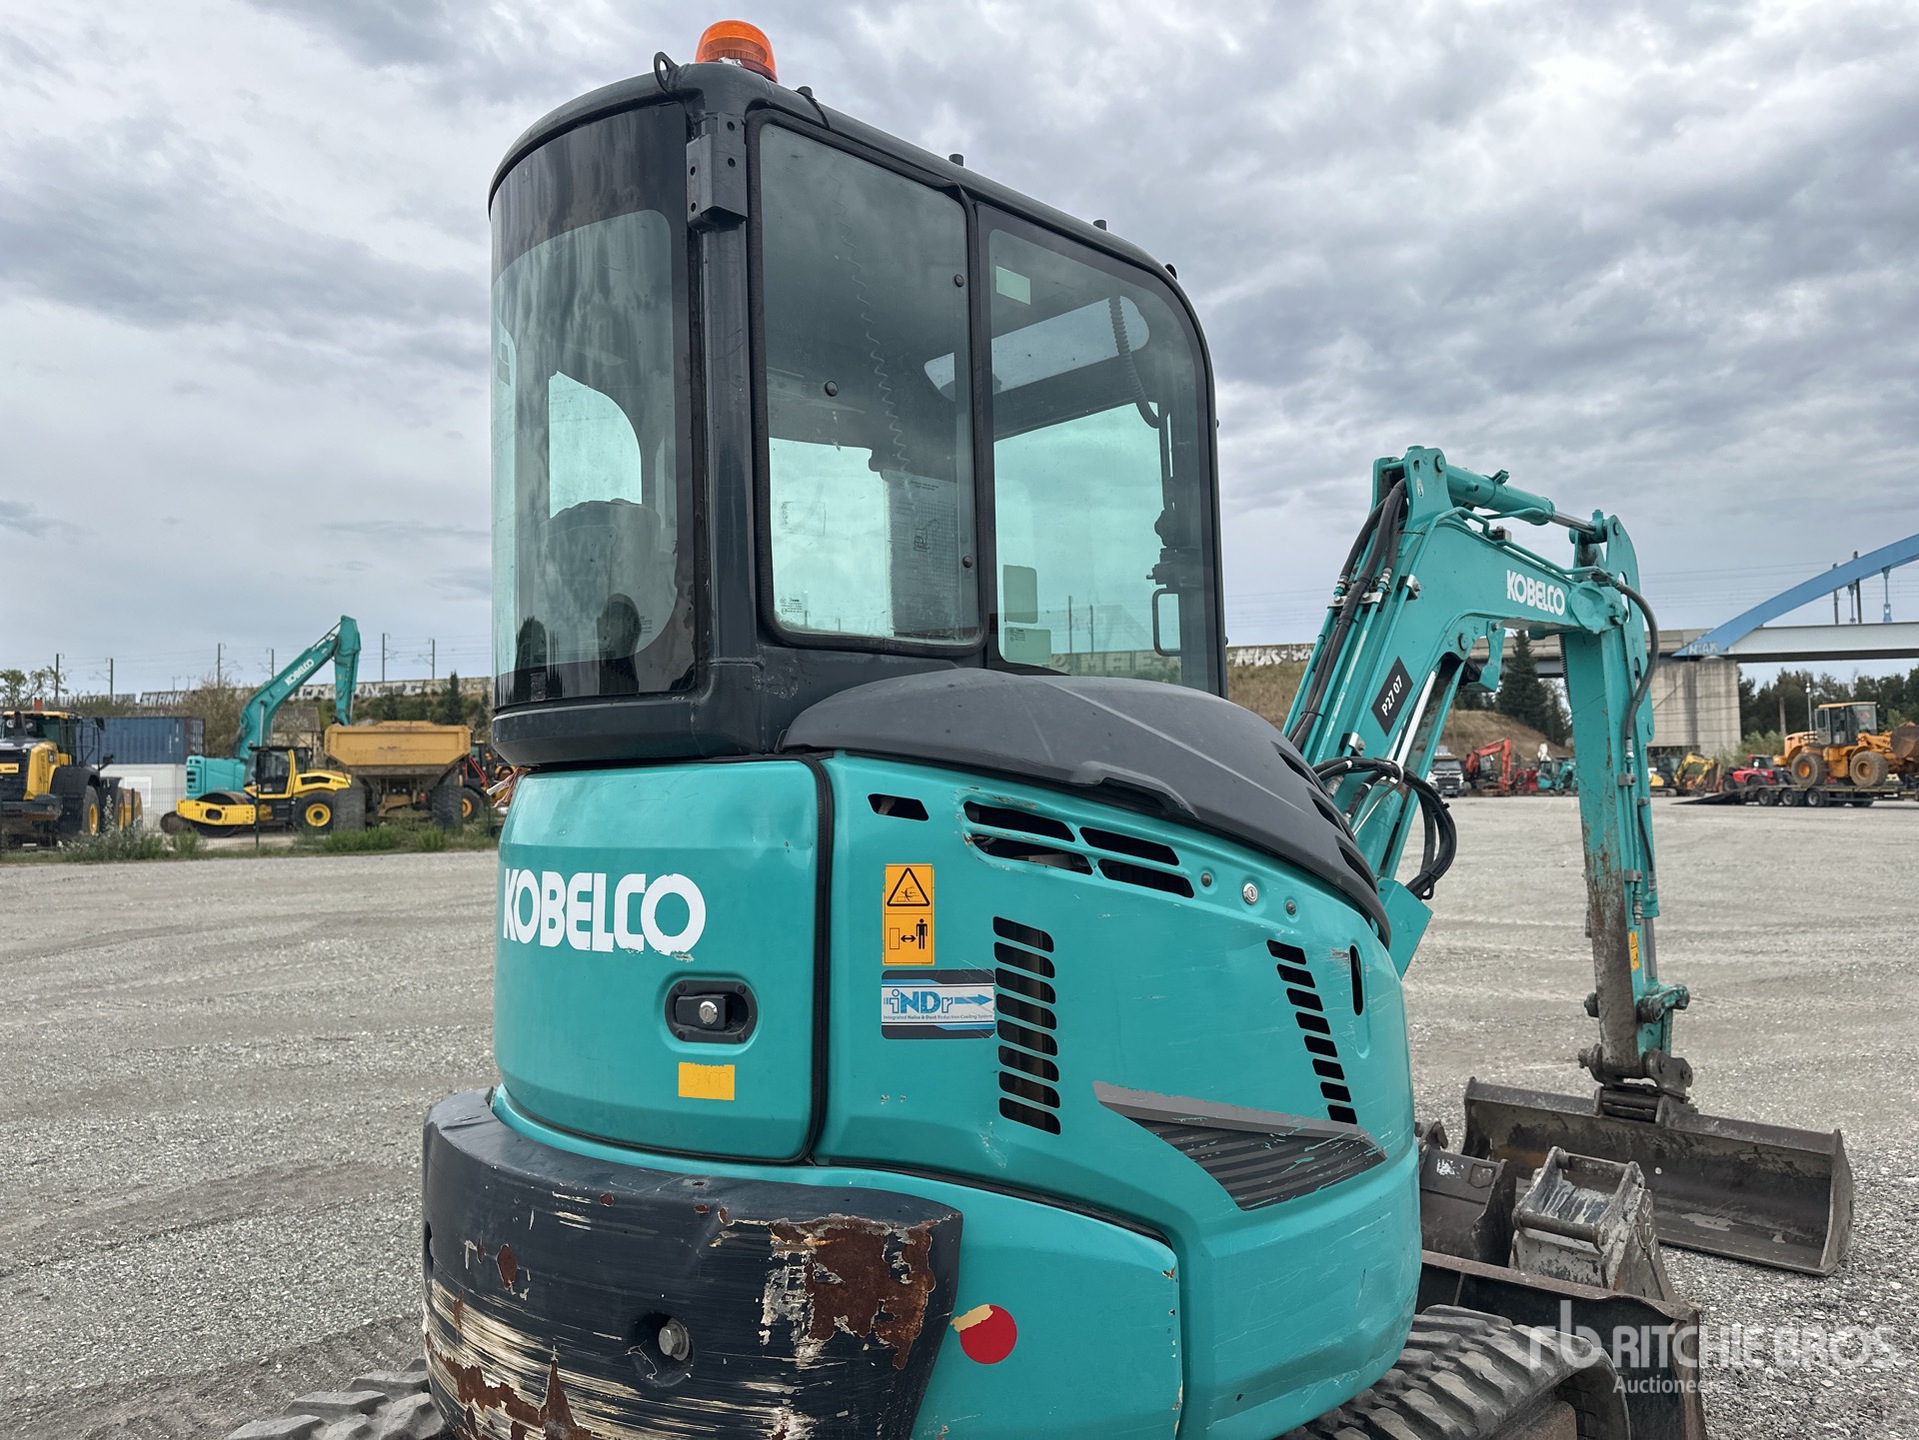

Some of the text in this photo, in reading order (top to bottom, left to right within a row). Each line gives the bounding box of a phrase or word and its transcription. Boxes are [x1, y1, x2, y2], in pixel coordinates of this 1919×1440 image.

[1507, 569, 1565, 616] KOBELCO
[284, 658, 314, 686] KOBELCO
[1381, 675, 1403, 716] P27 07
[503, 867, 707, 957] KOBELCO
